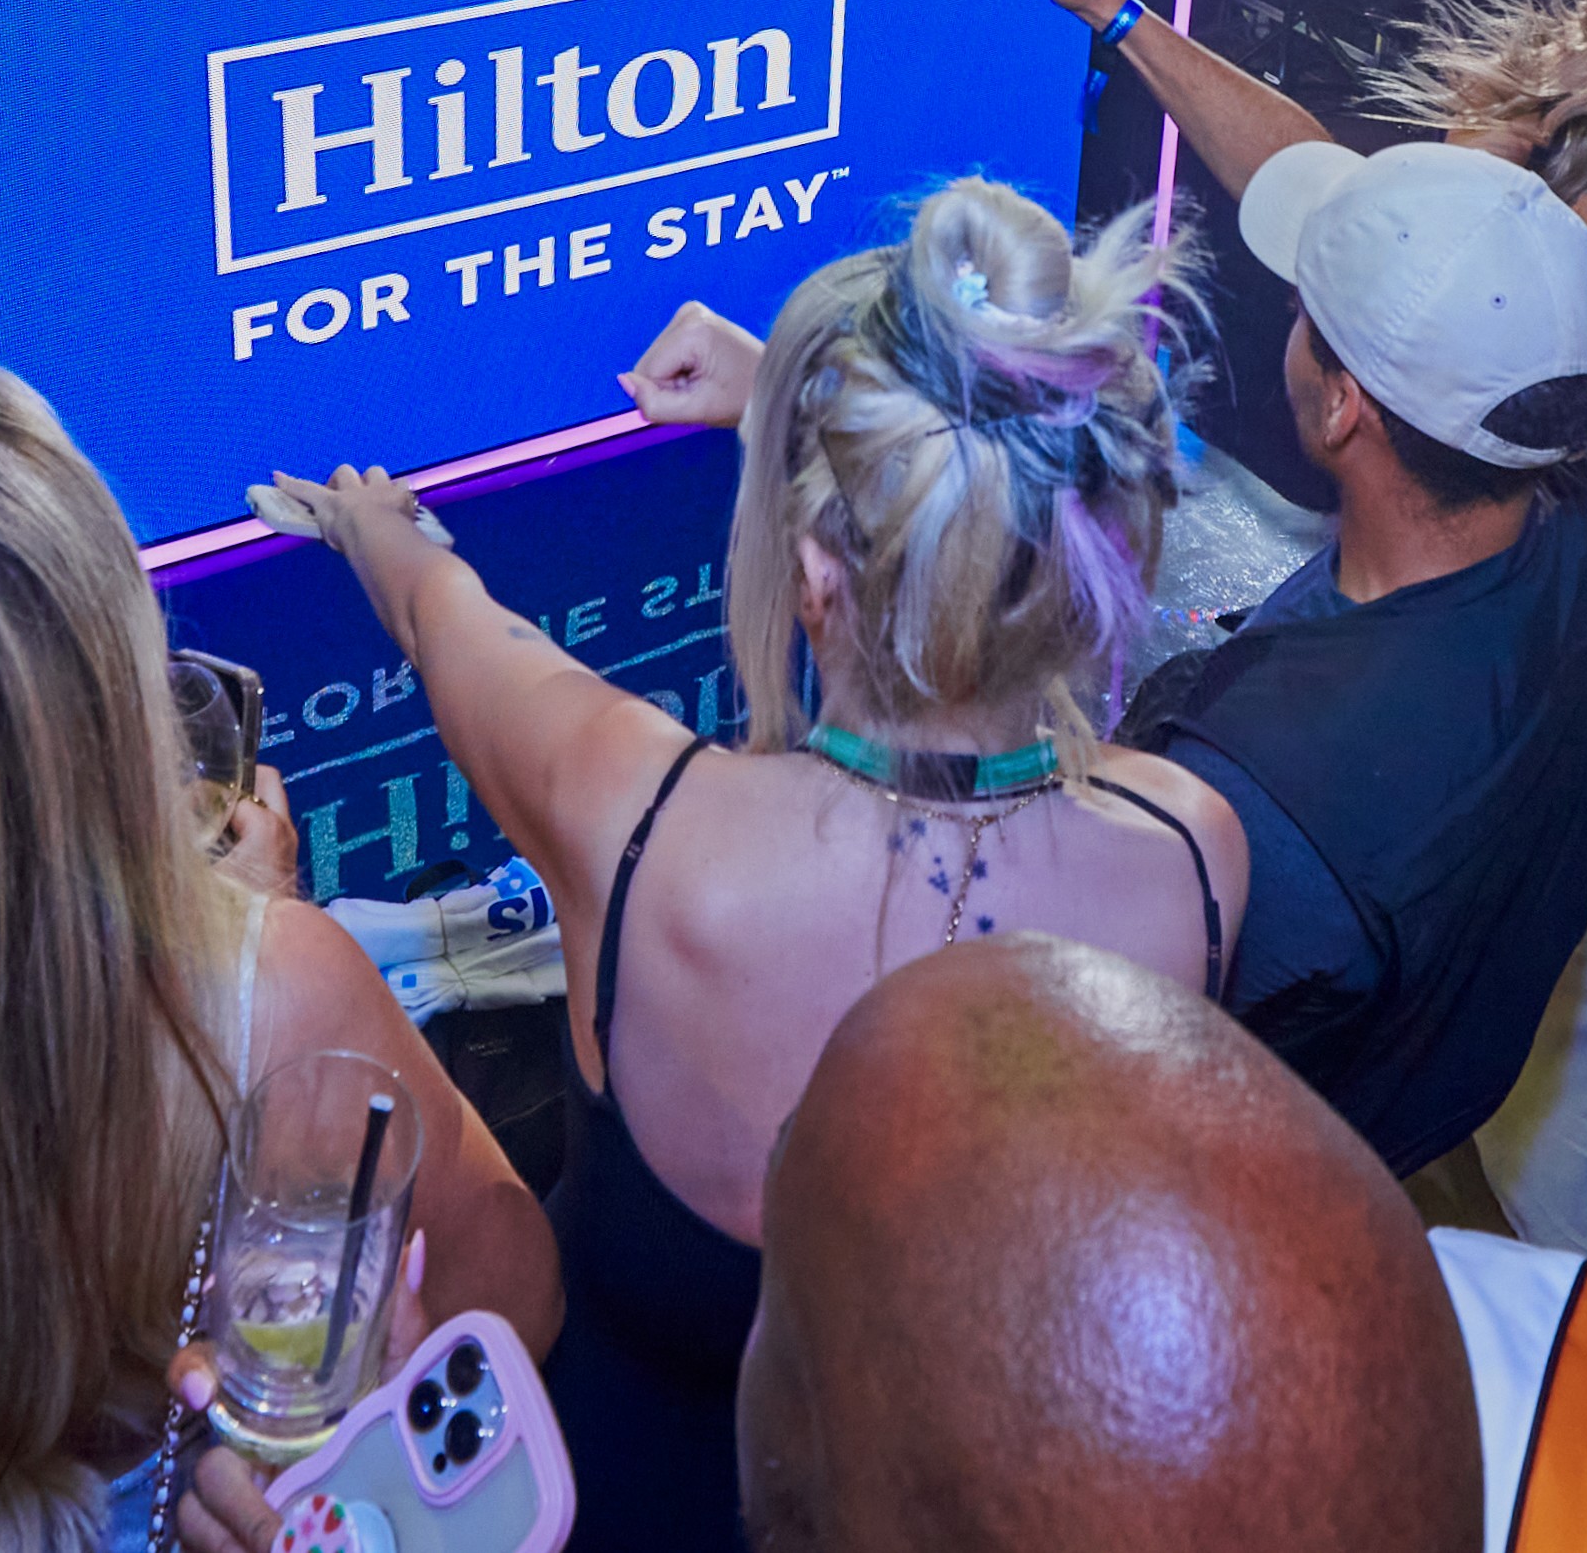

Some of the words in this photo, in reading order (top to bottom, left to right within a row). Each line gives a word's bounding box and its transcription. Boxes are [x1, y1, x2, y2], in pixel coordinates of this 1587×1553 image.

[272, 27, 797, 214] Hilton
[232, 272, 411, 361] FOR
[444, 223, 612, 307] THE
